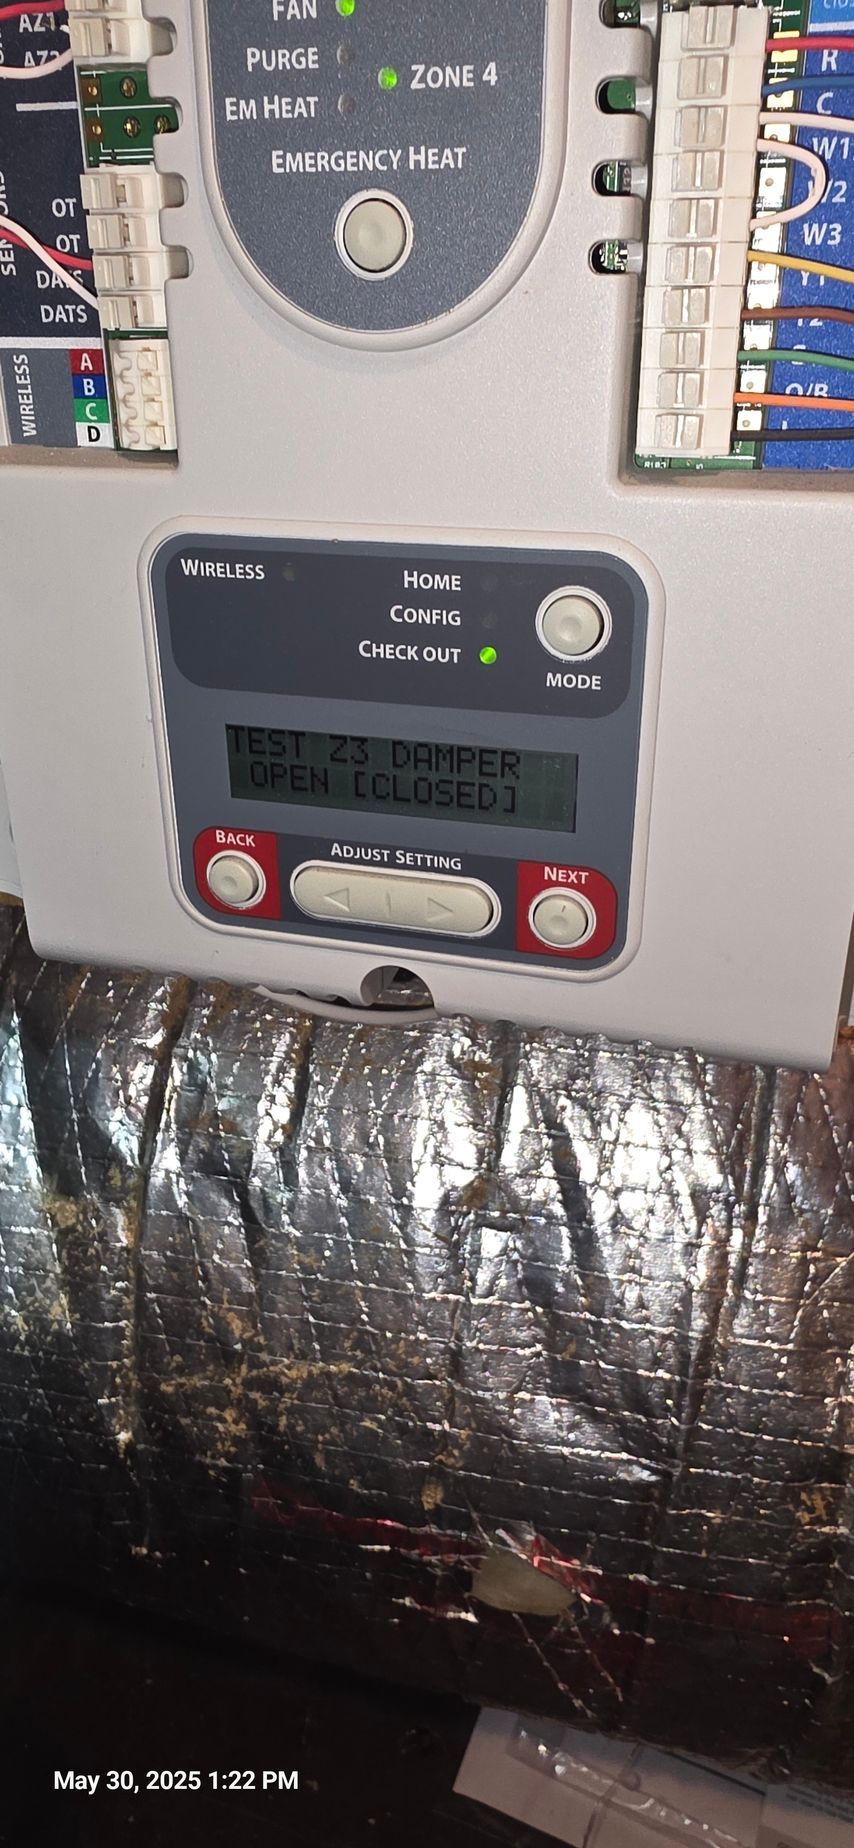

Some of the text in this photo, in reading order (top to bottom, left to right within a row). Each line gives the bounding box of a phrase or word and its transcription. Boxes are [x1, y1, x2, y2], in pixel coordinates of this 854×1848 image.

[272, 0, 317, 21] FAN
[19, 11, 56, 33] AZ1
[246, 47, 319, 72] PURGE
[821, 49, 839, 72] R
[410, 61, 498, 90] ZONE 4
[225, 94, 319, 121] EM HEAT
[815, 92, 834, 115] C
[271, 145, 467, 174] EMERGENCY HEAT
[811, 136, 850, 161] W1
[51, 197, 77, 218] OT
[55, 234, 81, 254] OT
[803, 221, 842, 246] W3
[36, 269, 84, 289] DAS
[40, 304, 88, 324] DATS
[80, 353, 93, 371] A
[12, 354, 37, 437] WIRELESS
[83, 379, 96, 397] B
[85, 402, 98, 421] C
[87, 425, 101, 443] D
[180, 558, 265, 580] WIRELESS
[403, 570, 462, 591] HOME
[390, 605, 461, 626] CONFIG
[358, 640, 462, 664] CHECK OUT
[546, 672, 602, 690] MODE
[226, 724, 521, 780] TEST Z3 DAMPER
[250, 761, 516, 813] OPEN [CLOSED]
[215, 829, 256, 847] BACK
[330, 842, 462, 871] ADJUST SETTING
[543, 866, 590, 885] NEXT
